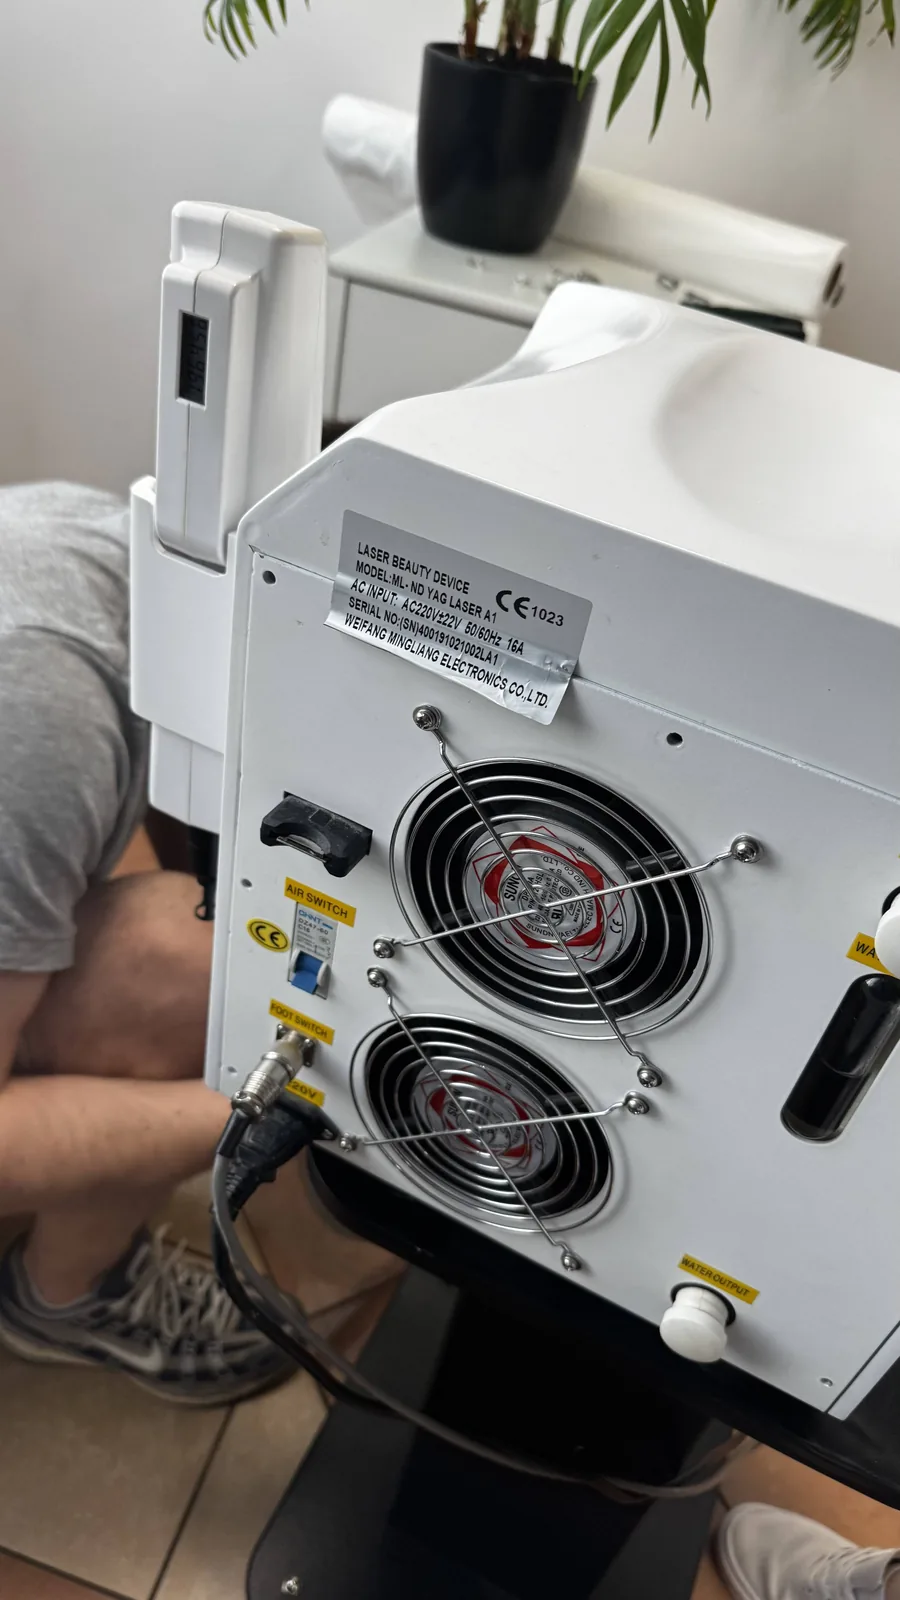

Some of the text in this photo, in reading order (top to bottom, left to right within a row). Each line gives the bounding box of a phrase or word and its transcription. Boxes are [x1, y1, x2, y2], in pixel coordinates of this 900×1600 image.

[357, 542, 470, 595] LASER BEAUTY DEVICE
[348, 596, 381, 620] SERIAL
[350, 578, 365, 593] AC
[367, 584, 398, 607] INPUT:
[464, 621, 502, 647] 50/60Hz
[507, 637, 524, 655] 16A
[410, 583, 425, 596] ND
[427, 588, 447, 605] YAG
[449, 595, 482, 619] LASER
[484, 610, 497, 624] A1
[531, 605, 565, 627] 1023
[344, 613, 387, 640] WEIFANG
[387, 630, 439, 663] MINGLIANG
[440, 653, 508, 691] ELECTRONICS
[286, 883, 348, 918] AIR SWITCH
[504, 864, 522, 901] SUN
[256, 925, 281, 947] CE
[270, 1003, 328, 1039] FOOT SWITCH
[681, 1257, 750, 1297] WATER OUTPUT
